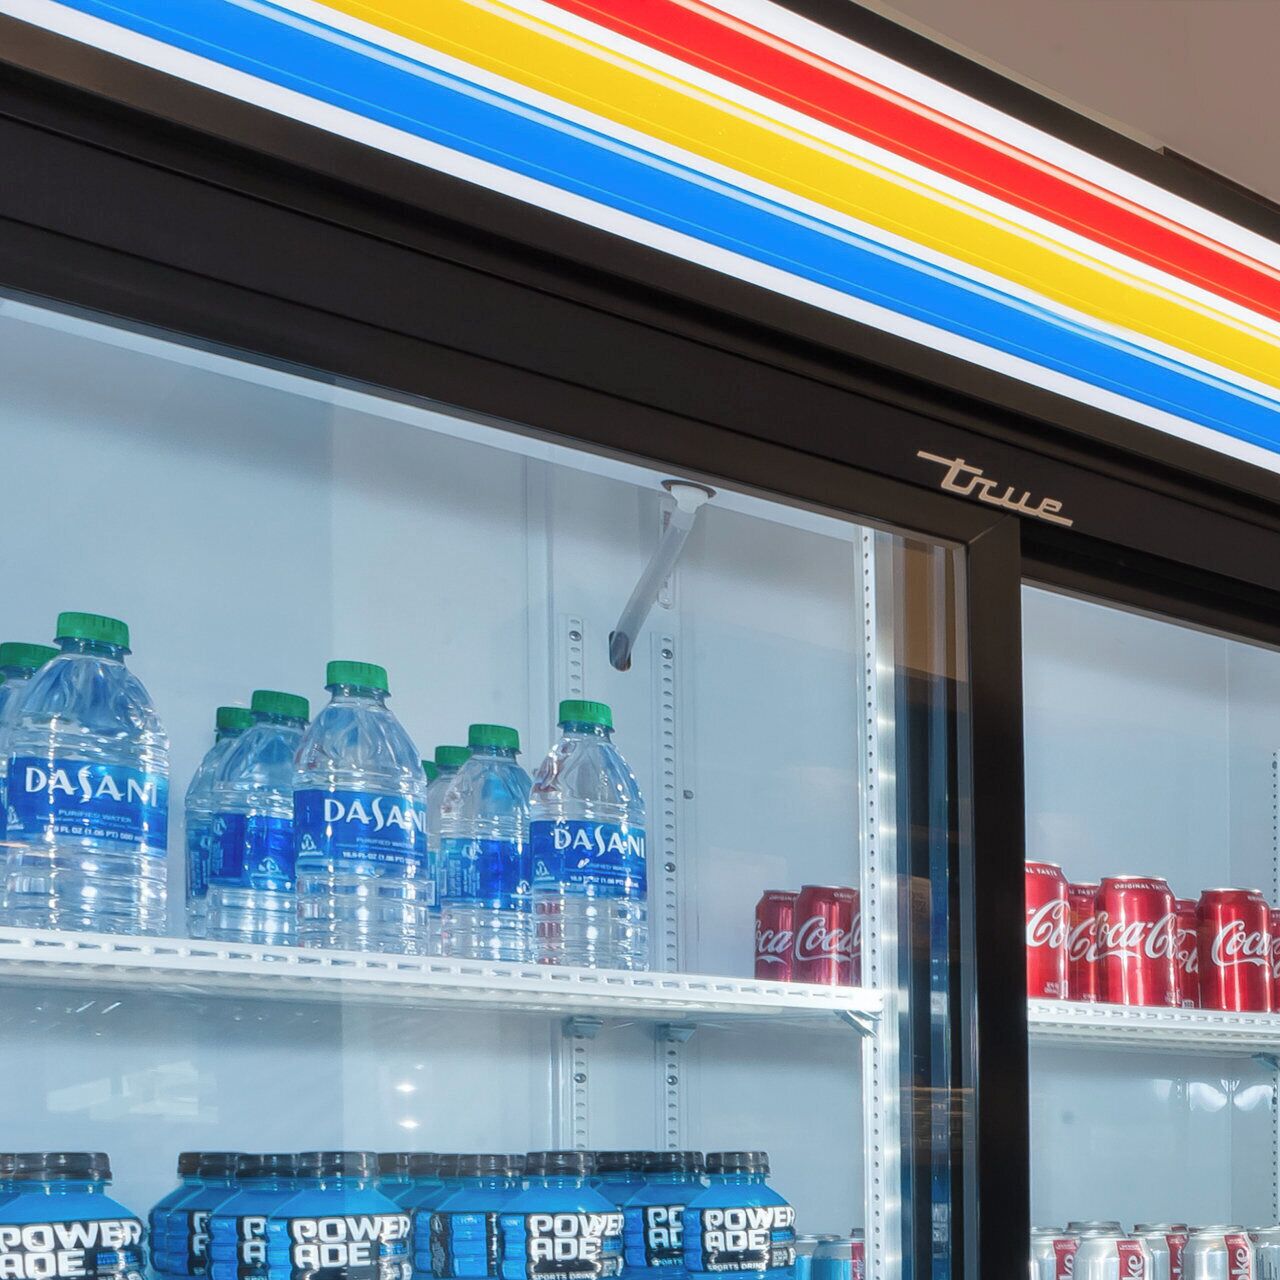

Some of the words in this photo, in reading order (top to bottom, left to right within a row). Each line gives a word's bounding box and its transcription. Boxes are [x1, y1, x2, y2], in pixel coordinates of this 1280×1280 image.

[25, 765, 158, 808] DASANI
[324, 797, 430, 837] DASANI
[554, 825, 645, 860] DASANI
[1115, 882, 1149, 890] ORIGINAL
[292, 1215, 411, 1244] POWER
[529, 1213, 625, 1238] POWER
[704, 1206, 796, 1232] POWER
[0, 1219, 142, 1254] POWER
[530, 1238, 601, 1263] ADE
[704, 1229, 771, 1254] ADE
[0, 1250, 87, 1280] ADE
[293, 1241, 372, 1269] ADE
[707, 1262, 740, 1272] SPORTS
